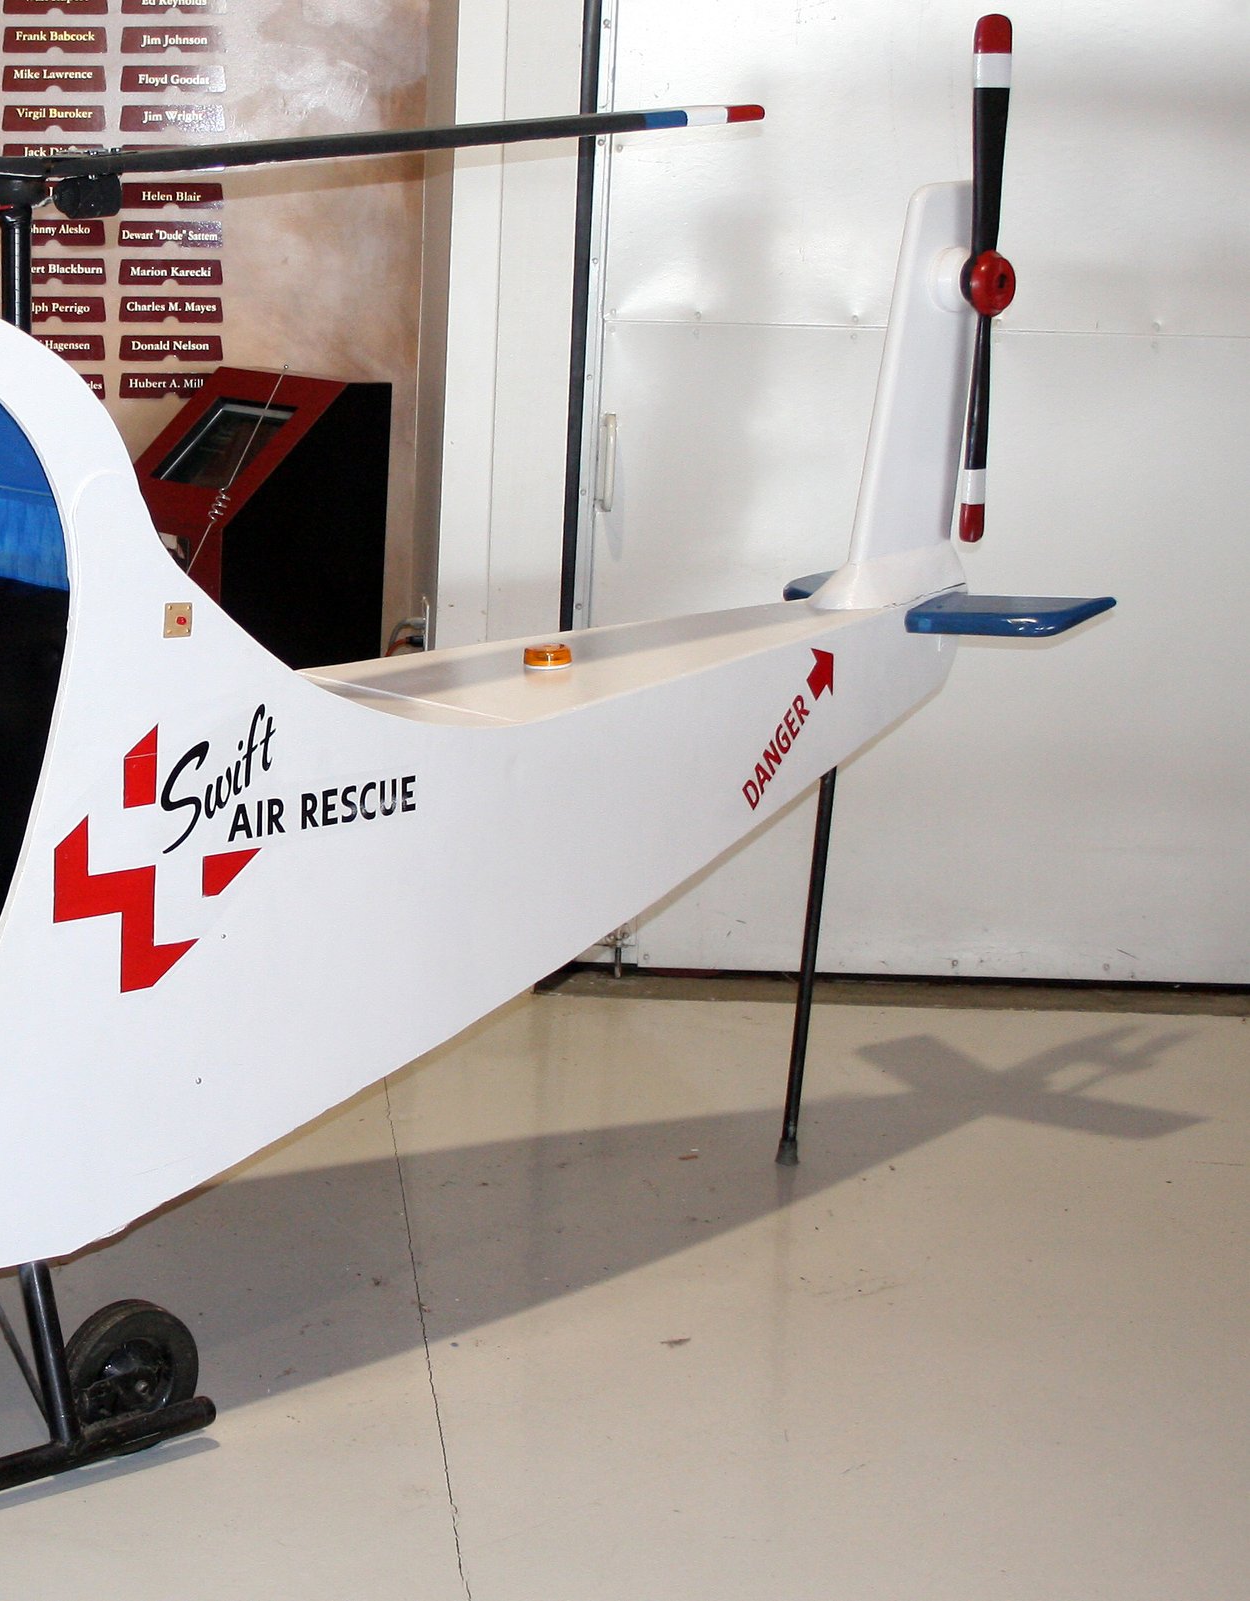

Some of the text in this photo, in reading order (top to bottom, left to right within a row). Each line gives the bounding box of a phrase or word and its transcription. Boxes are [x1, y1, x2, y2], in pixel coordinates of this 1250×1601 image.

[15, 31, 95, 41] Frank Babcock
[141, 35, 208, 47] Jim Johnson
[13, 69, 93, 79] Mike Lawrence
[138, 74, 168, 87] Floyd
[16, 108, 93, 120] Virgil Buroker
[142, 109, 203, 124] Jim Wright
[24, 147, 47, 157] Jack
[142, 191, 202, 202] Helen Blair
[30, 224, 90, 236] hnny Alesko
[155, 229, 187, 240] "Dude"
[48, 264, 103, 274] Blackburn
[130, 266, 212, 277] Marion Karecki
[31, 303, 90, 315] lph Perrigo
[126, 301, 217, 314] Charles M. Mayes
[45, 340, 90, 352] Hagensen
[131, 341, 210, 351] Donald Nelson
[129, 378, 204, 389] Hubert A. Mill
[741, 694, 810, 811] DANGER
[160, 703, 276, 854] Swift
[228, 775, 416, 842] AIR RESCUE
